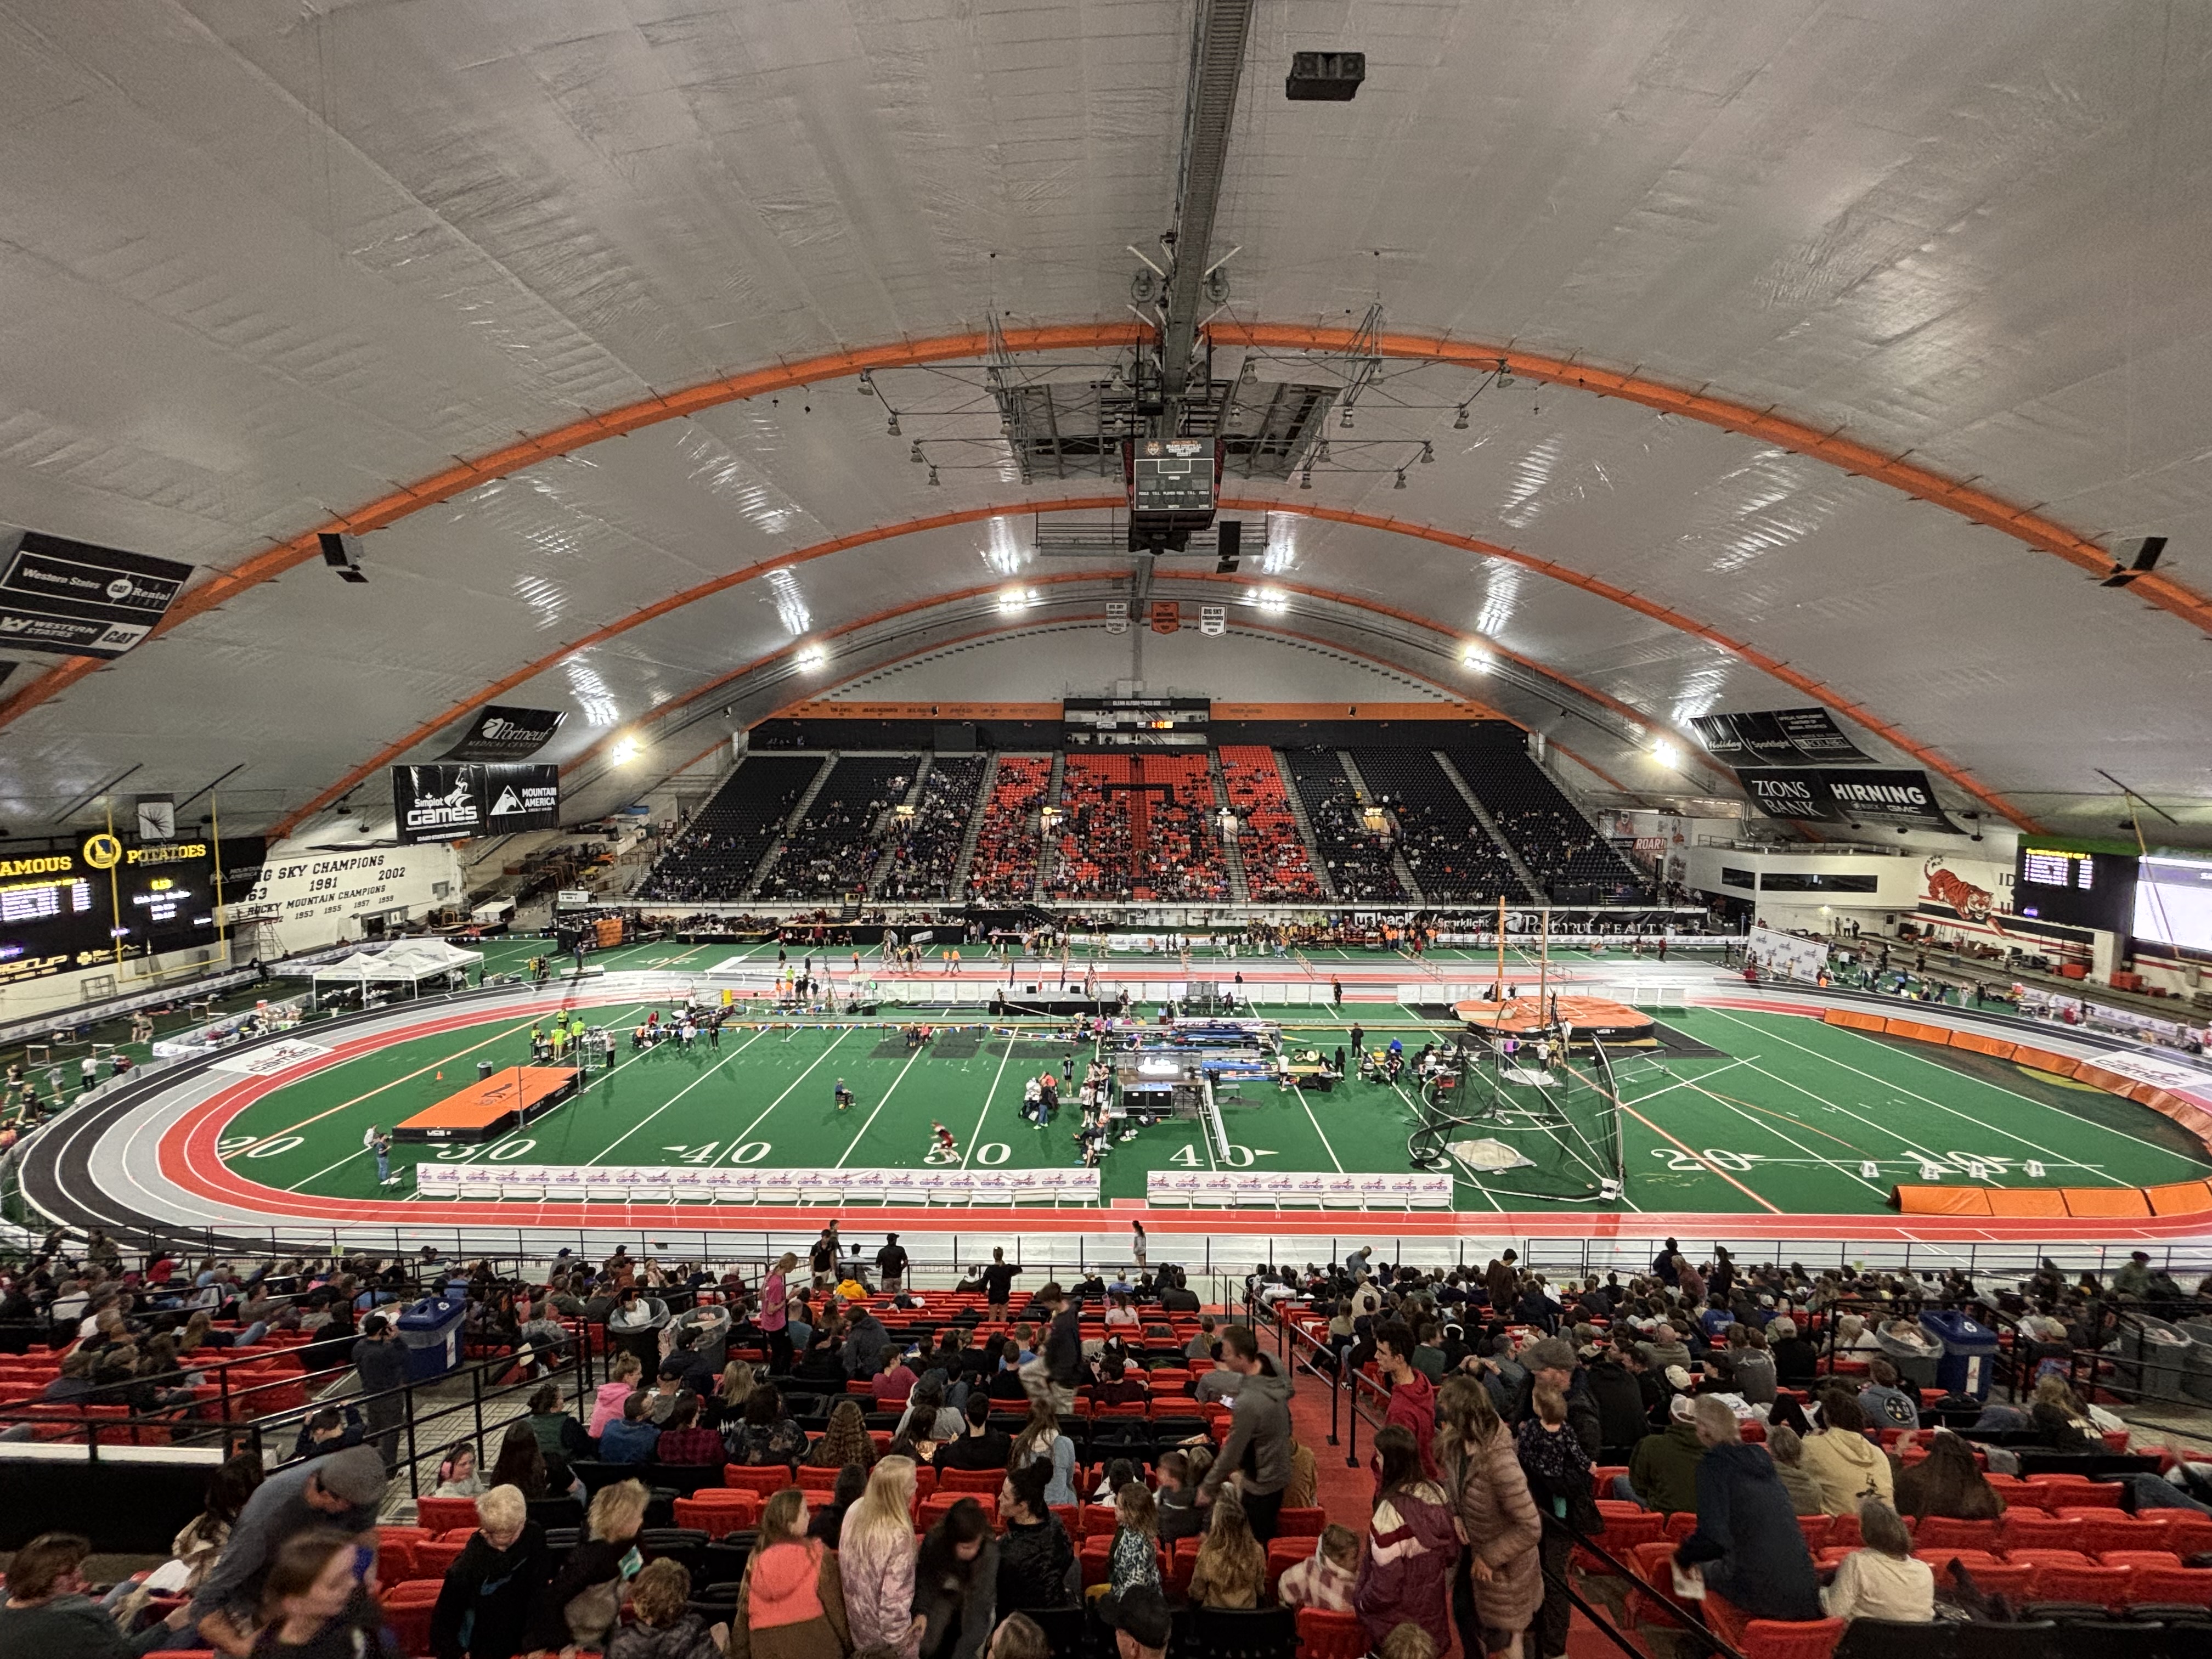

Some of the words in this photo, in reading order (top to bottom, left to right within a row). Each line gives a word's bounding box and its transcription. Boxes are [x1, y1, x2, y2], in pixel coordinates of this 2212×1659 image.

[22, 567, 68, 584] Western
[69, 577, 101, 589] States
[111, 584, 128, 593] CAT
[132, 587, 171, 601] Rental
[25, 628, 74, 638] STATES
[33, 621, 98, 634] WESTERN
[101, 631, 139, 645] CAT
[495, 722, 552, 742] Portneuf
[1709, 741, 1741, 749] Holiday
[522, 787, 557, 798] MOUNTAIN
[1751, 780, 1810, 799] ZIONS
[1830, 784, 1927, 805] HIRNING
[415, 797, 444, 809] Simplot
[524, 797, 556, 808] AMERICA
[1762, 799, 1828, 817] BANK
[1886, 805, 1922, 814] GMC
[1636, 838, 1664, 850] ROAR!
[127, 844, 206, 864] POTATOES
[258, 870, 273, 882] IG
[278, 864, 308, 879] SKY
[313, 855, 385, 874] CHAMPIONS
[309, 877, 338, 891] 1981
[378, 867, 406, 881] 2002
[247, 902, 283, 916] ROCKY
[286, 893, 335, 909] MOUNTAIN
[338, 885, 386, 900] CHAMPIONS
[295, 910, 314, 920] 1953
[324, 905, 342, 915] 1955
[353, 900, 370, 909] 1957
[679, 1141, 771, 1164] 40
